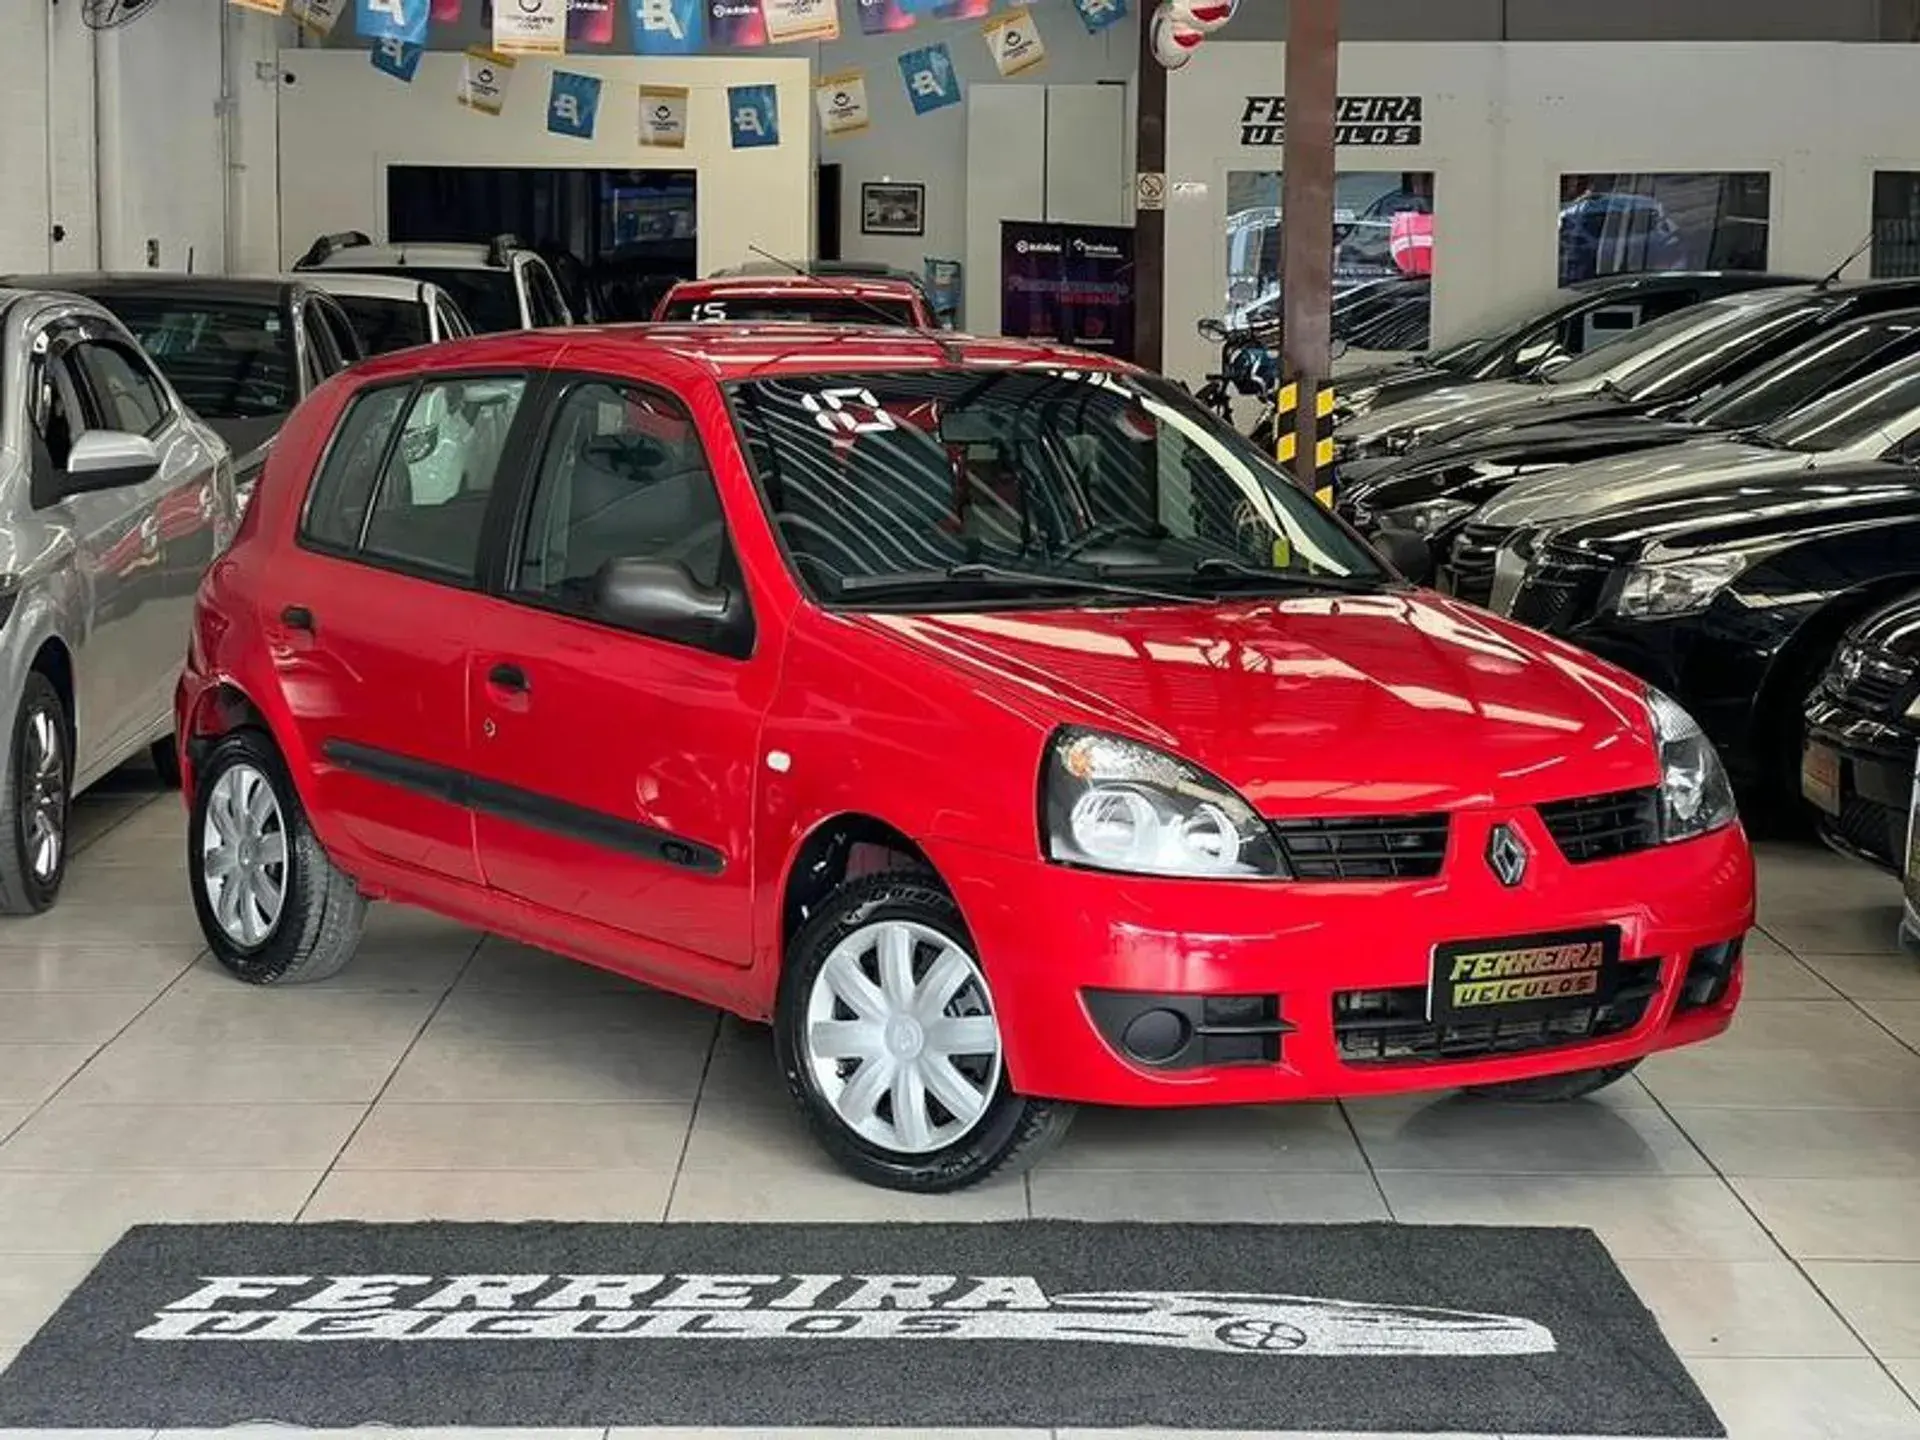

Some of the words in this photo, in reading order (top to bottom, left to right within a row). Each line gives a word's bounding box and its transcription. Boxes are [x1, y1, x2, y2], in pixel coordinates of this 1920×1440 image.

[1242, 96, 1422, 122] FEEIRA
[1450, 941, 1604, 981] FERREIRA
[163, 1273, 1052, 1310] FERREIRA
